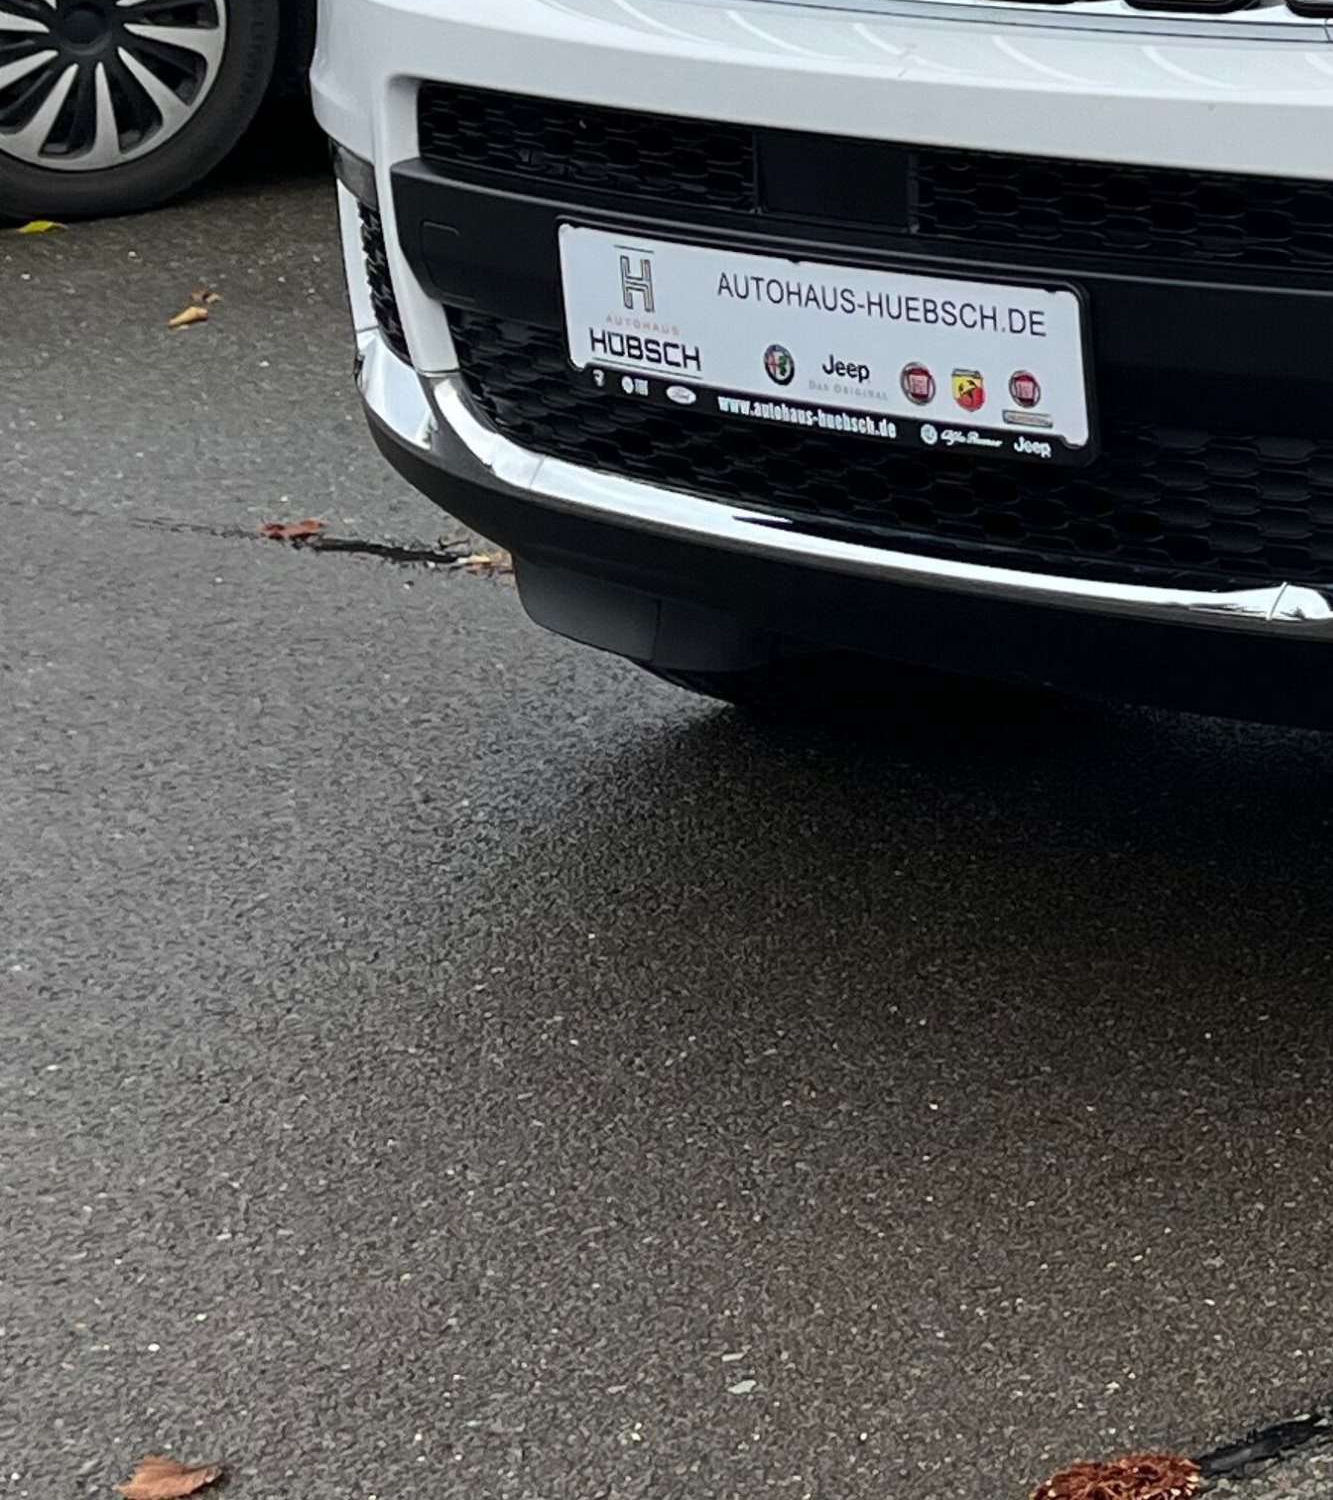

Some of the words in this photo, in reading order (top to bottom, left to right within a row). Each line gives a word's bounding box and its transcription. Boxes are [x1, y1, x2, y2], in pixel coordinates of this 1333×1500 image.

[717, 271, 1047, 338] AUTOHAUS-HUEBSCH.DE
[821, 353, 871, 385] Jeep
[717, 395, 898, 439] www.autohaus-huebsch.de
